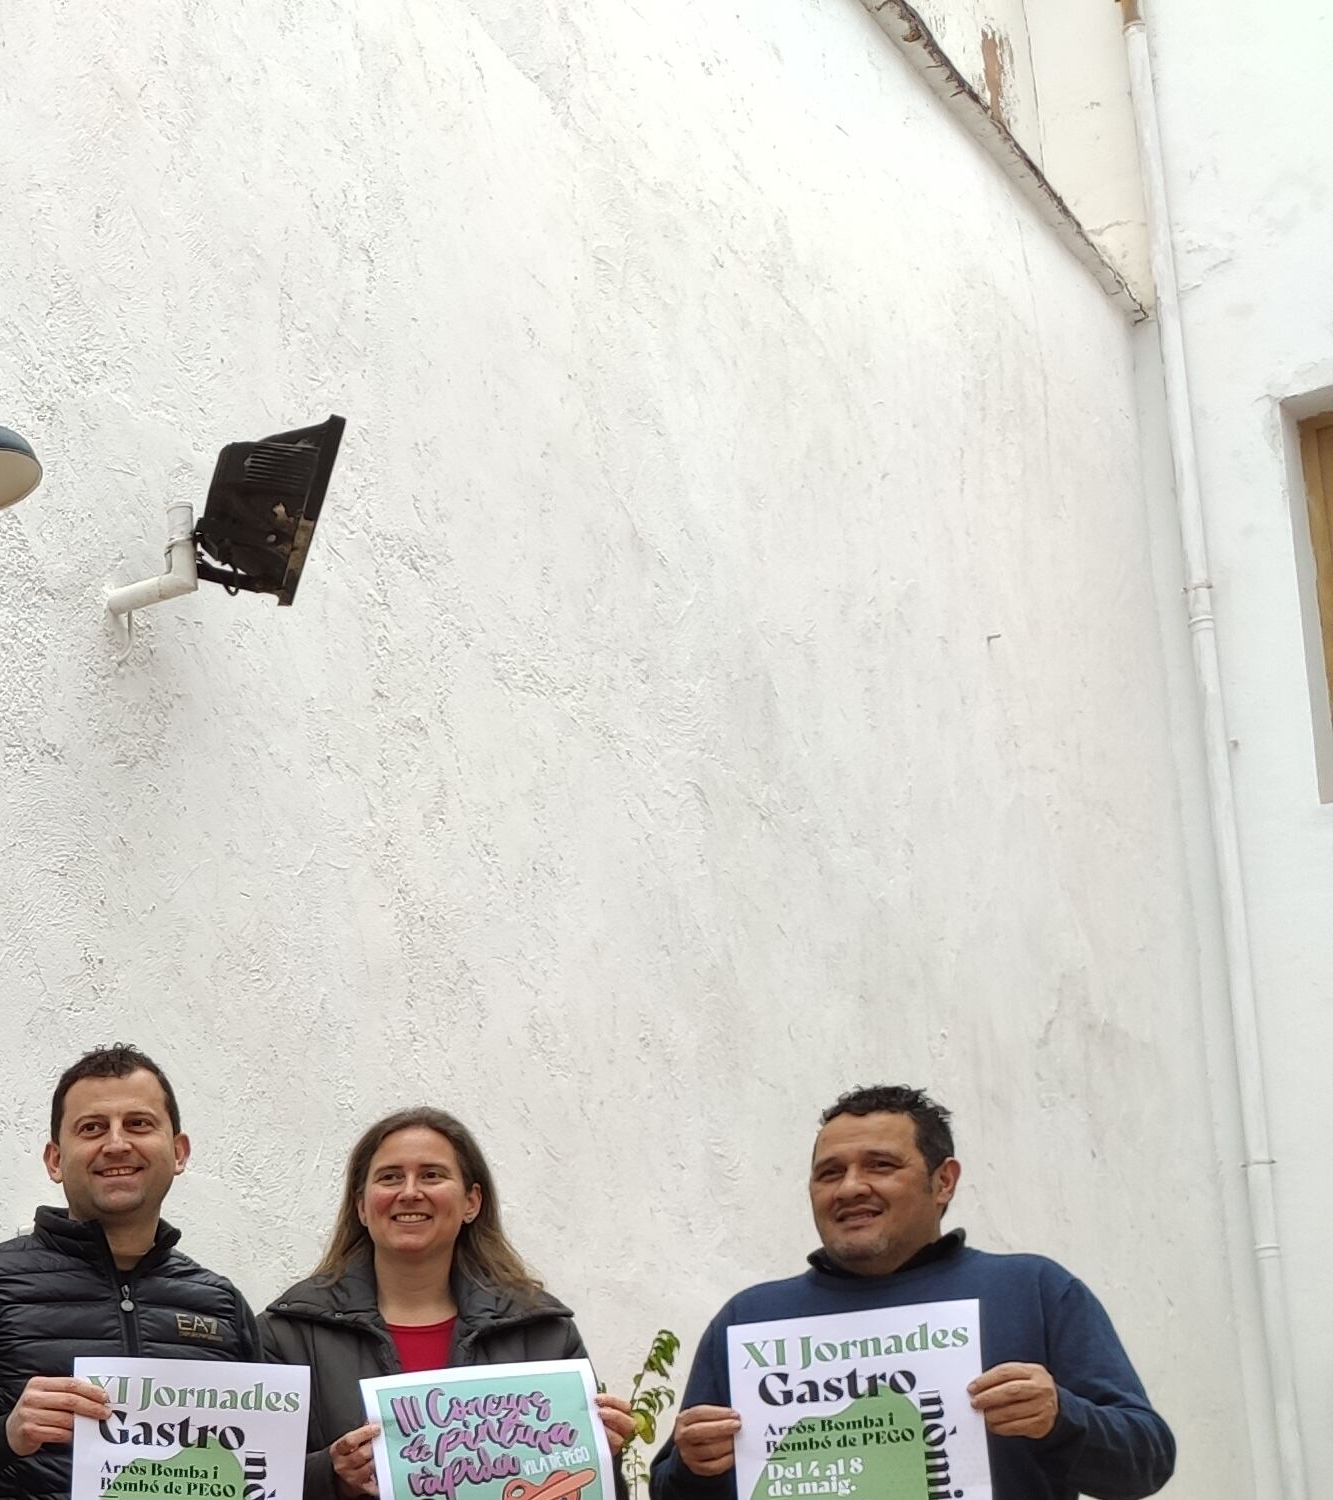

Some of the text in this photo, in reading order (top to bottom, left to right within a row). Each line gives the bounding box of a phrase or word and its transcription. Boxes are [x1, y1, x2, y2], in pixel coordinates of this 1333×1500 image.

[741, 1322, 969, 1370] XI Jornades
[137, 1377, 301, 1413] Jornades
[758, 1368, 917, 1406] Gastro
[391, 1388, 551, 1437] III Concurs
[764, 1412, 894, 1436] Arròs Bomba i
[98, 1409, 245, 1450] Gastro
[400, 1415, 579, 1467] de pintura
[766, 1428, 915, 1453] Bombó de PEGO
[100, 1460, 218, 1479] Arròs Bomba i
[523, 1458, 549, 1476] VILA
[766, 1457, 863, 1480] Del 4 al 8
[100, 1477, 235, 1497] Bombó de PEGO
[768, 1475, 855, 1496] de maig.
